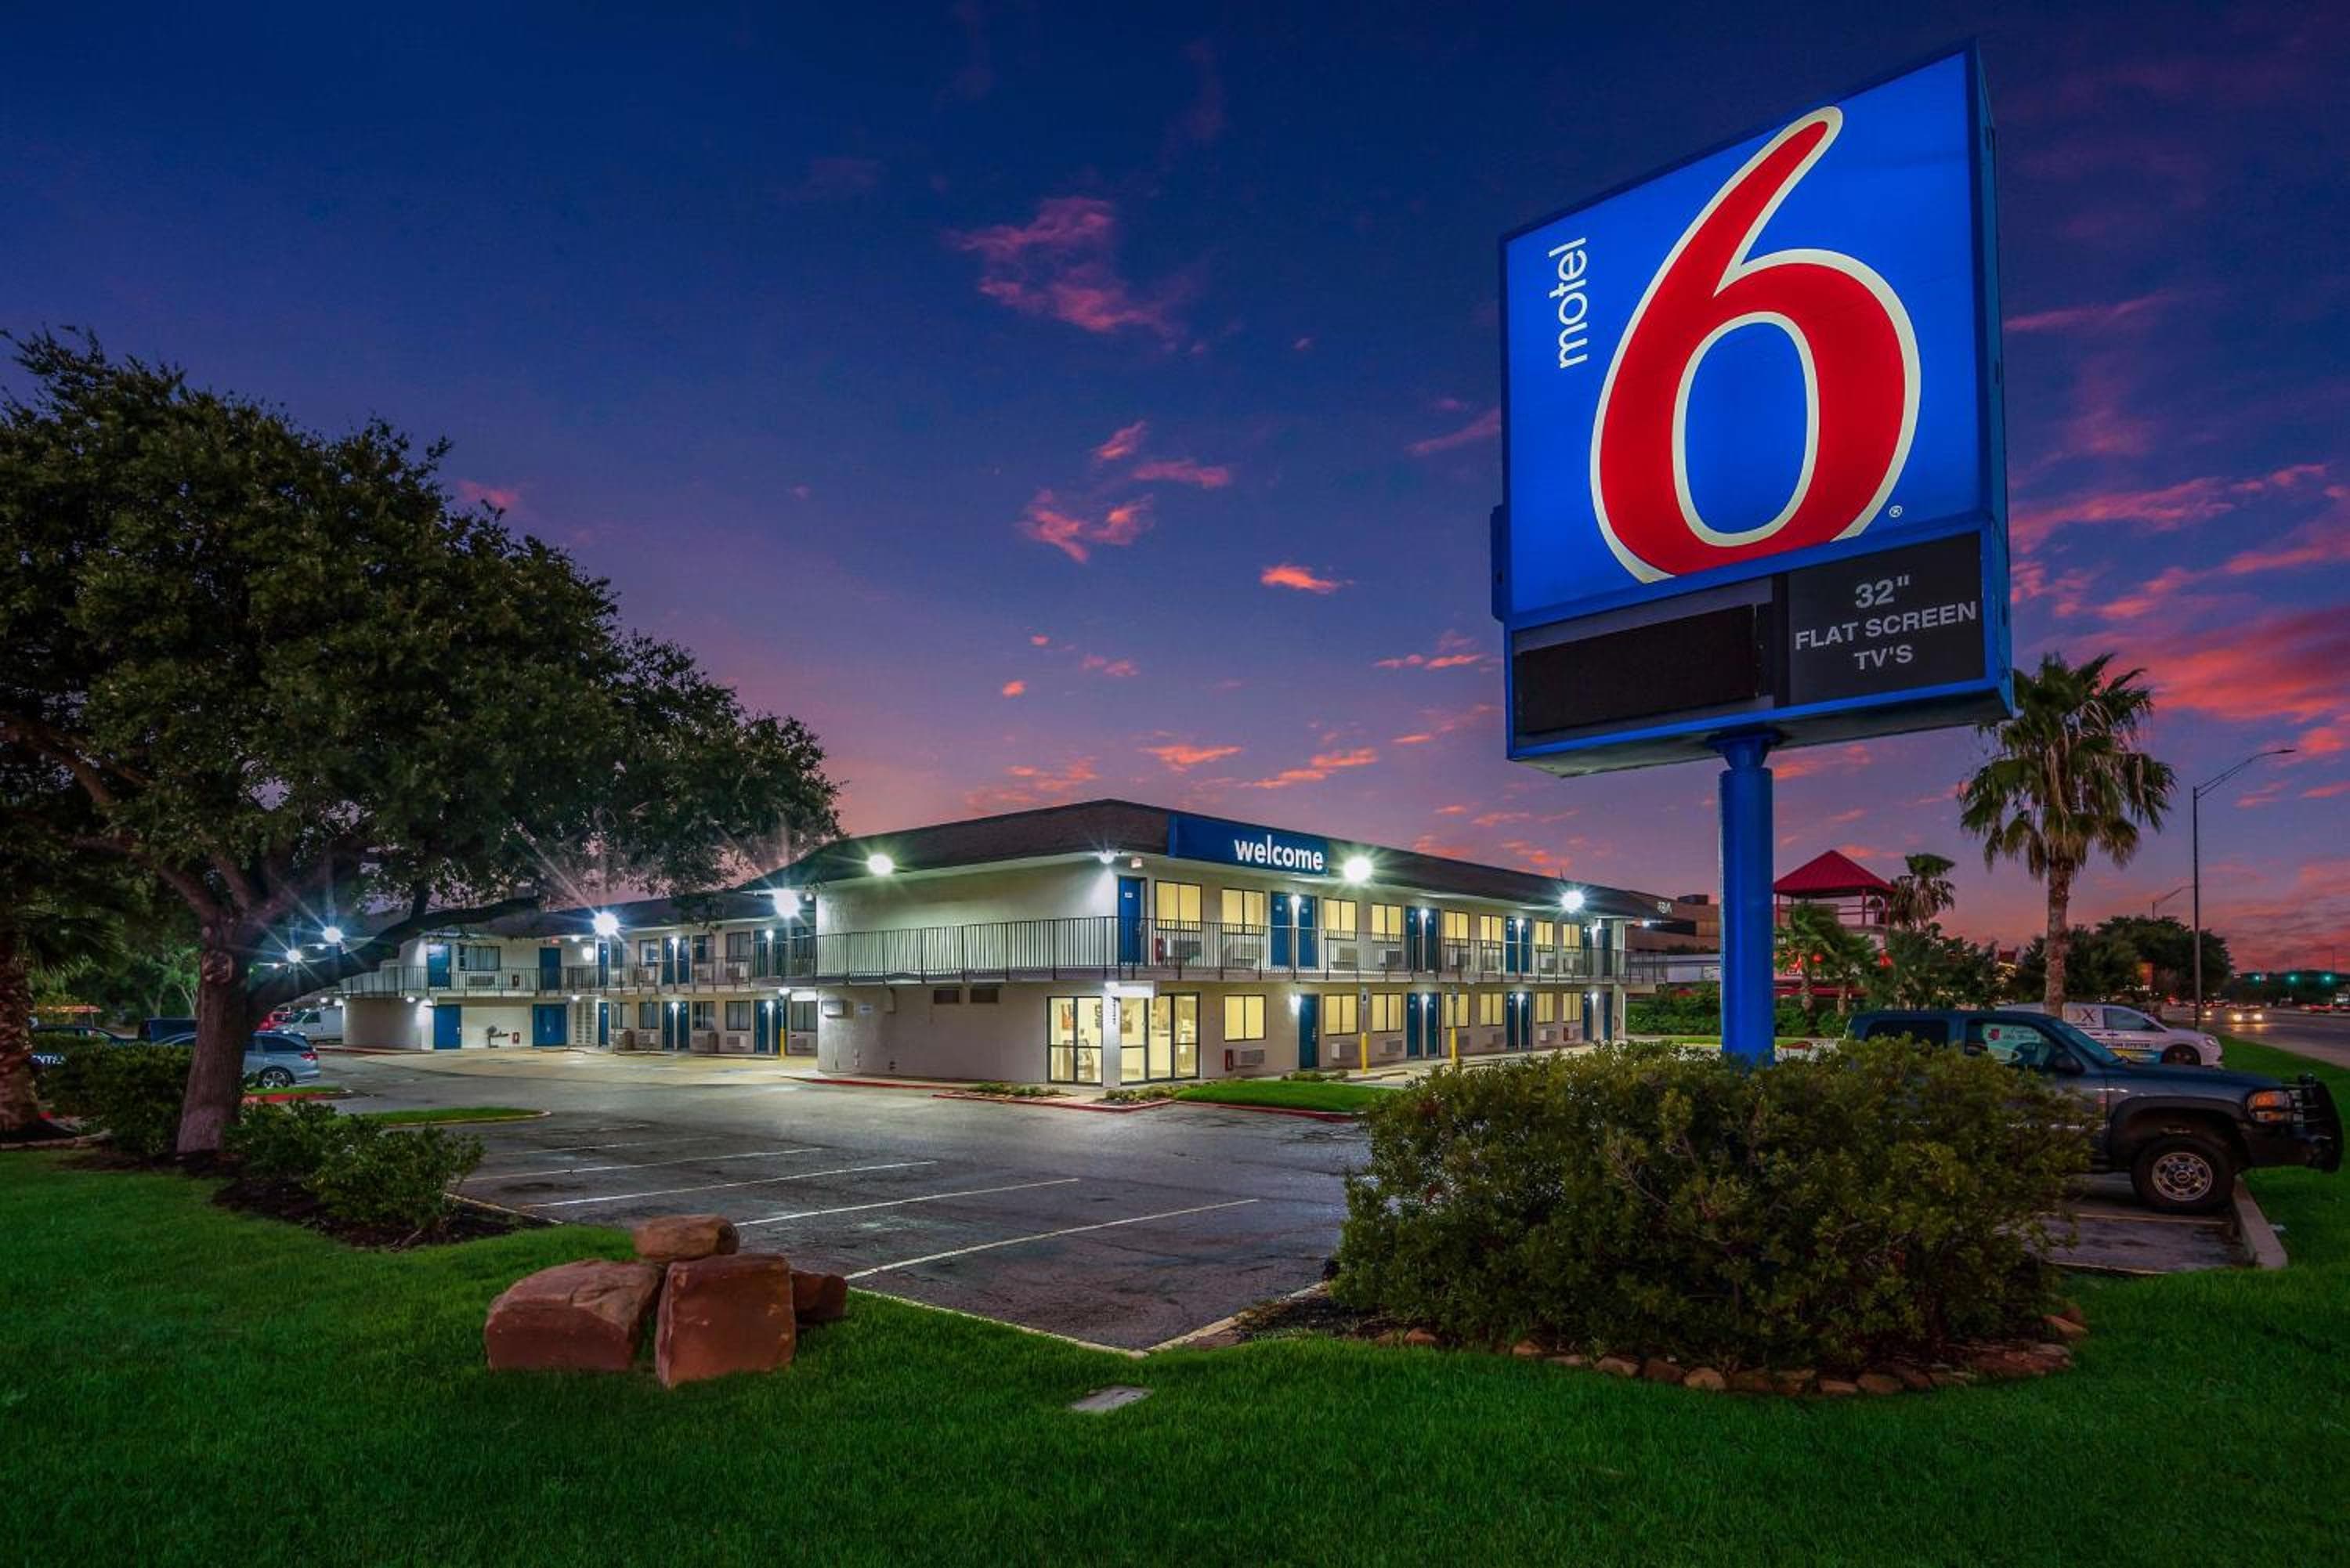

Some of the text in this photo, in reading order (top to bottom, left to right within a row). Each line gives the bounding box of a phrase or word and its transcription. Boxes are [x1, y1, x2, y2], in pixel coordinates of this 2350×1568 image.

[1549, 237, 1588, 369] motel
[1589, 106, 1922, 584] 6
[1855, 575, 1910, 609] 32"
[1795, 601, 1976, 650] FLAT SCREEN
[1854, 645, 1913, 670] TV'S
[1234, 834, 1323, 871] welcome
